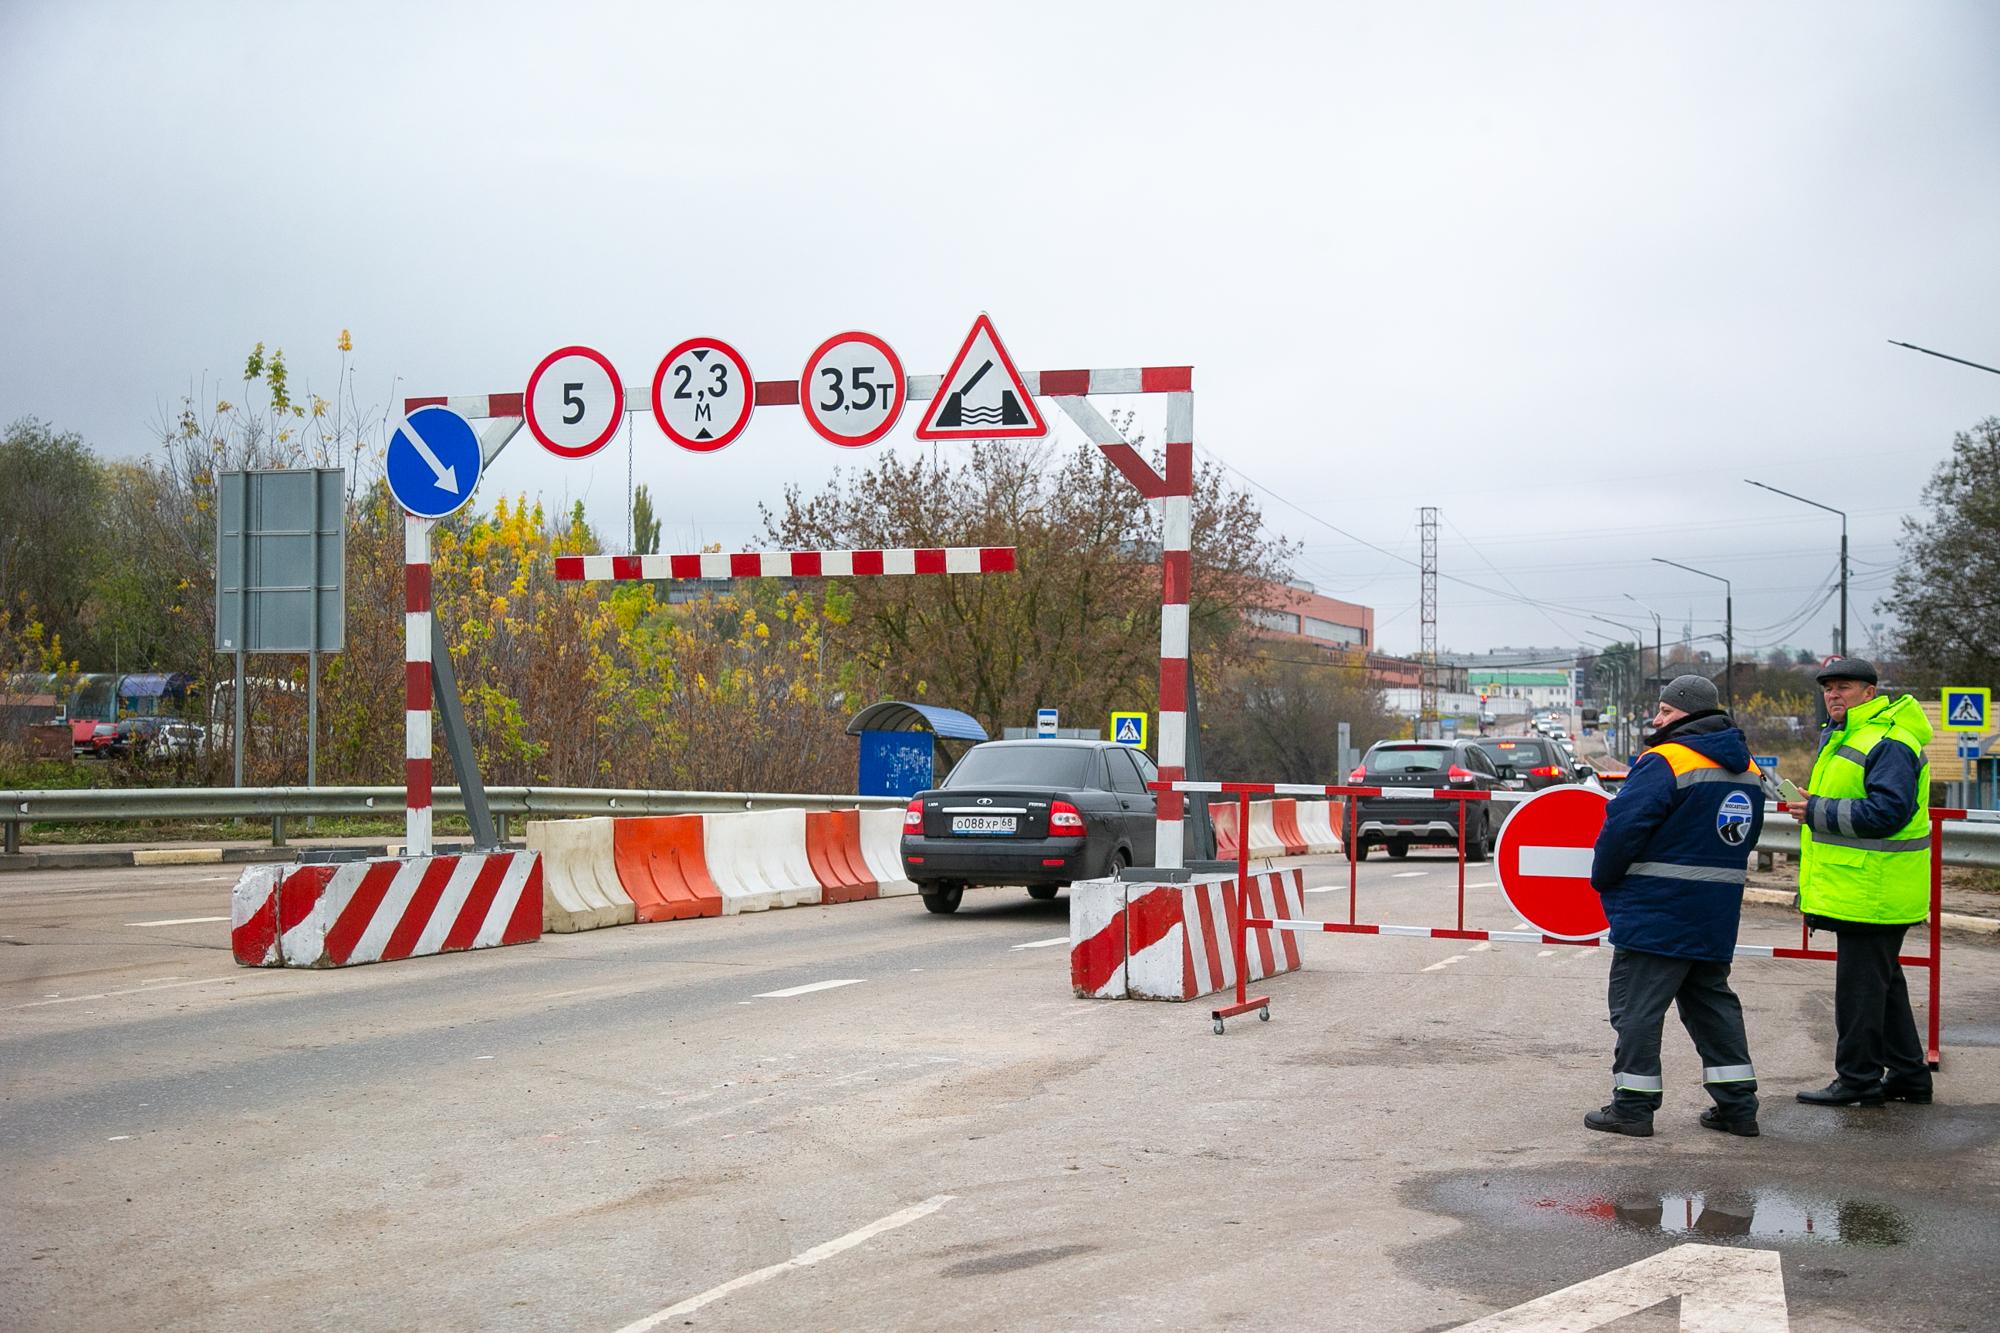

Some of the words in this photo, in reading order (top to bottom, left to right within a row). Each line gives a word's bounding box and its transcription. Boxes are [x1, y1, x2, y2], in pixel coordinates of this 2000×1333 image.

[673, 363, 728, 402] 2,3
[562, 383, 585, 424] 5
[1001, 818, 1013, 827] 68
